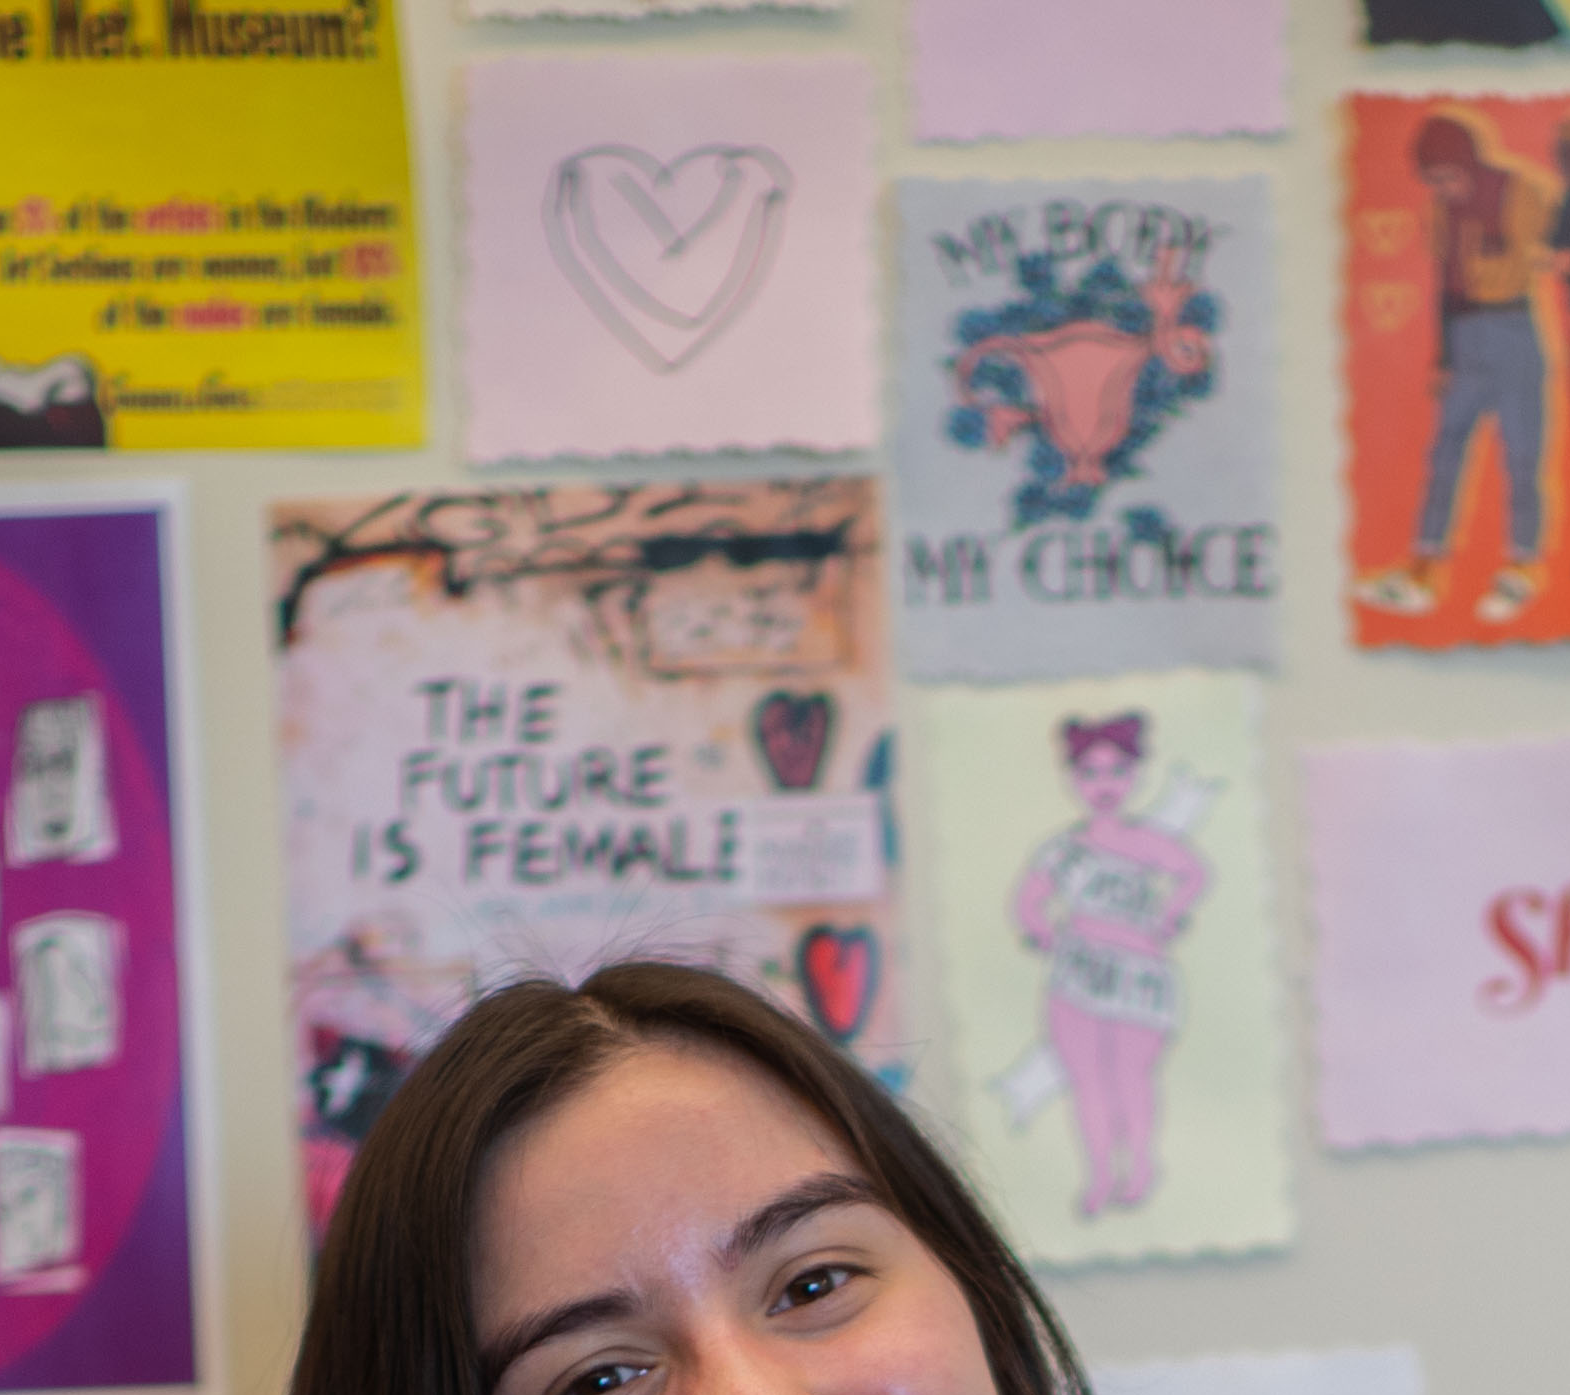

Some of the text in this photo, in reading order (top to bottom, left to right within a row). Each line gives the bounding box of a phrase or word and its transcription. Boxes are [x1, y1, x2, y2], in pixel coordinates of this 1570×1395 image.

[905, 522, 1280, 606] MY CHOICE
[414, 675, 562, 744] THE
[398, 743, 674, 814] FUTURE
[350, 817, 423, 888] IS
